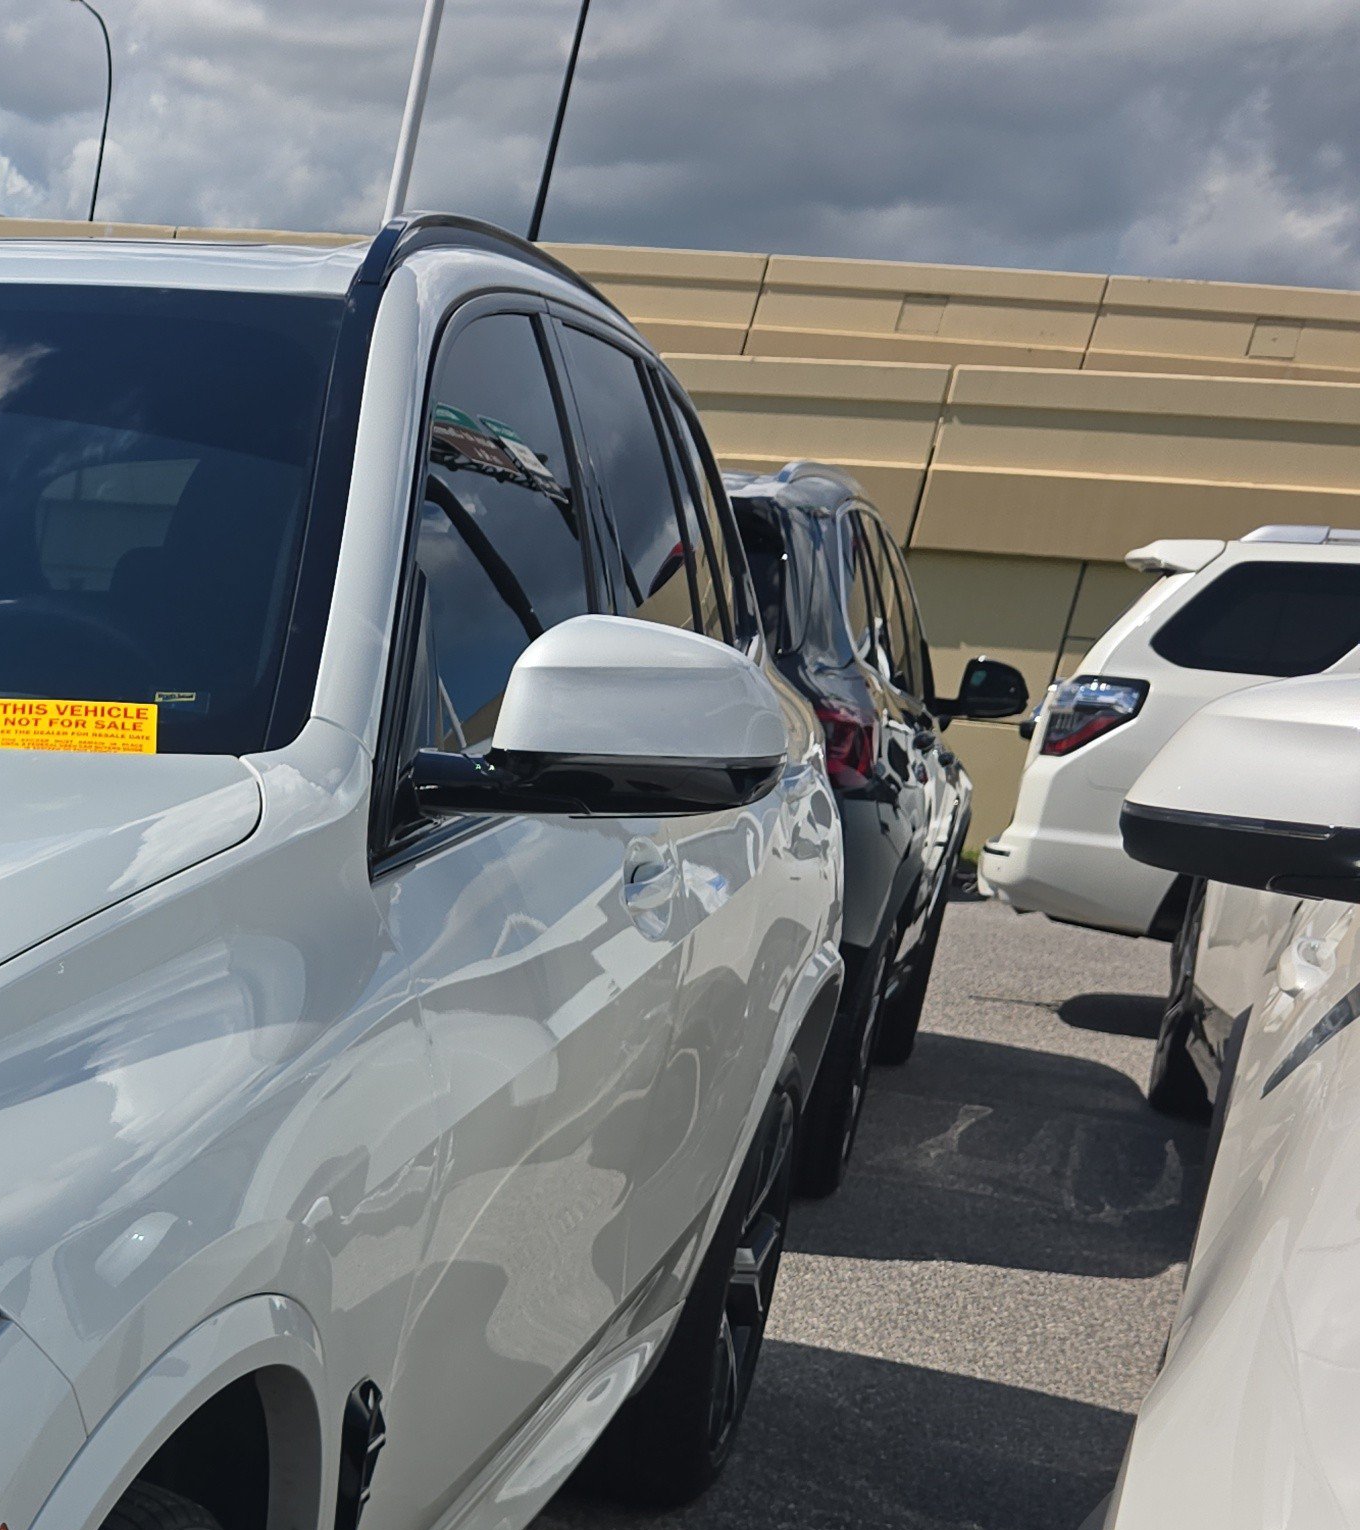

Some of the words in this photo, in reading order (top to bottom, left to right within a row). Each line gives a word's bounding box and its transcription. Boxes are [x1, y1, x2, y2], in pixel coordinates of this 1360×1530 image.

[0, 703, 48, 716] THIS
[56, 703, 149, 720] VEHICLE
[4, 717, 42, 727] NOT
[48, 718, 87, 729] FOR
[94, 719, 144, 732] SALE
